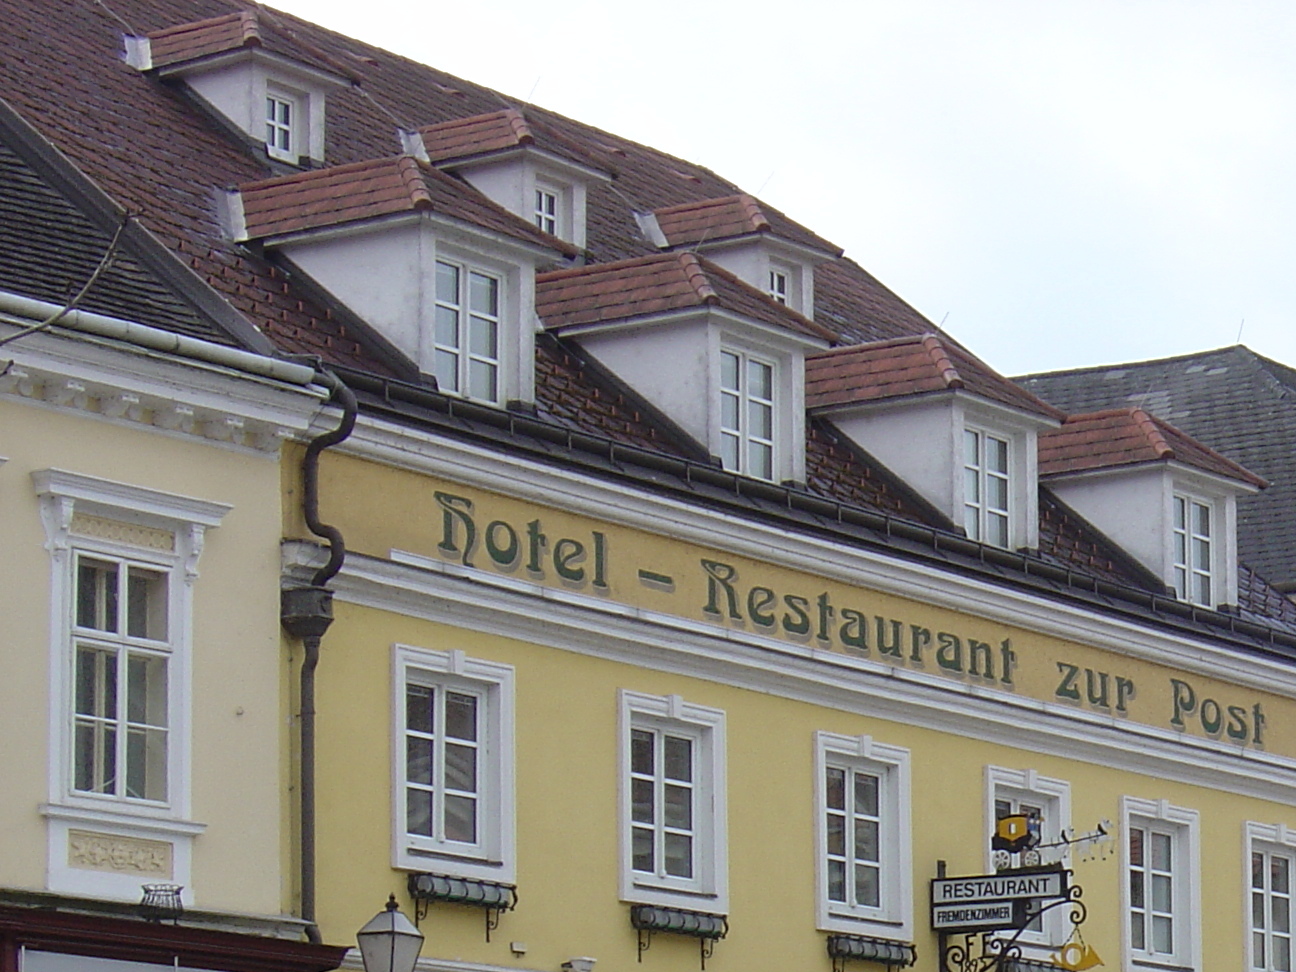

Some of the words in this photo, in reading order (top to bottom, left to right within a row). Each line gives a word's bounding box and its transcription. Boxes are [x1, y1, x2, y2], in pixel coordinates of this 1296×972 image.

[434, 491, 608, 588] Hotel
[701, 558, 1015, 685] Restaurant
[1055, 661, 1134, 712] zur
[1170, 678, 1265, 744] Post
[943, 878, 1050, 899] RESTAURANT
[937, 906, 1010, 923] FREMDENZIMMER
